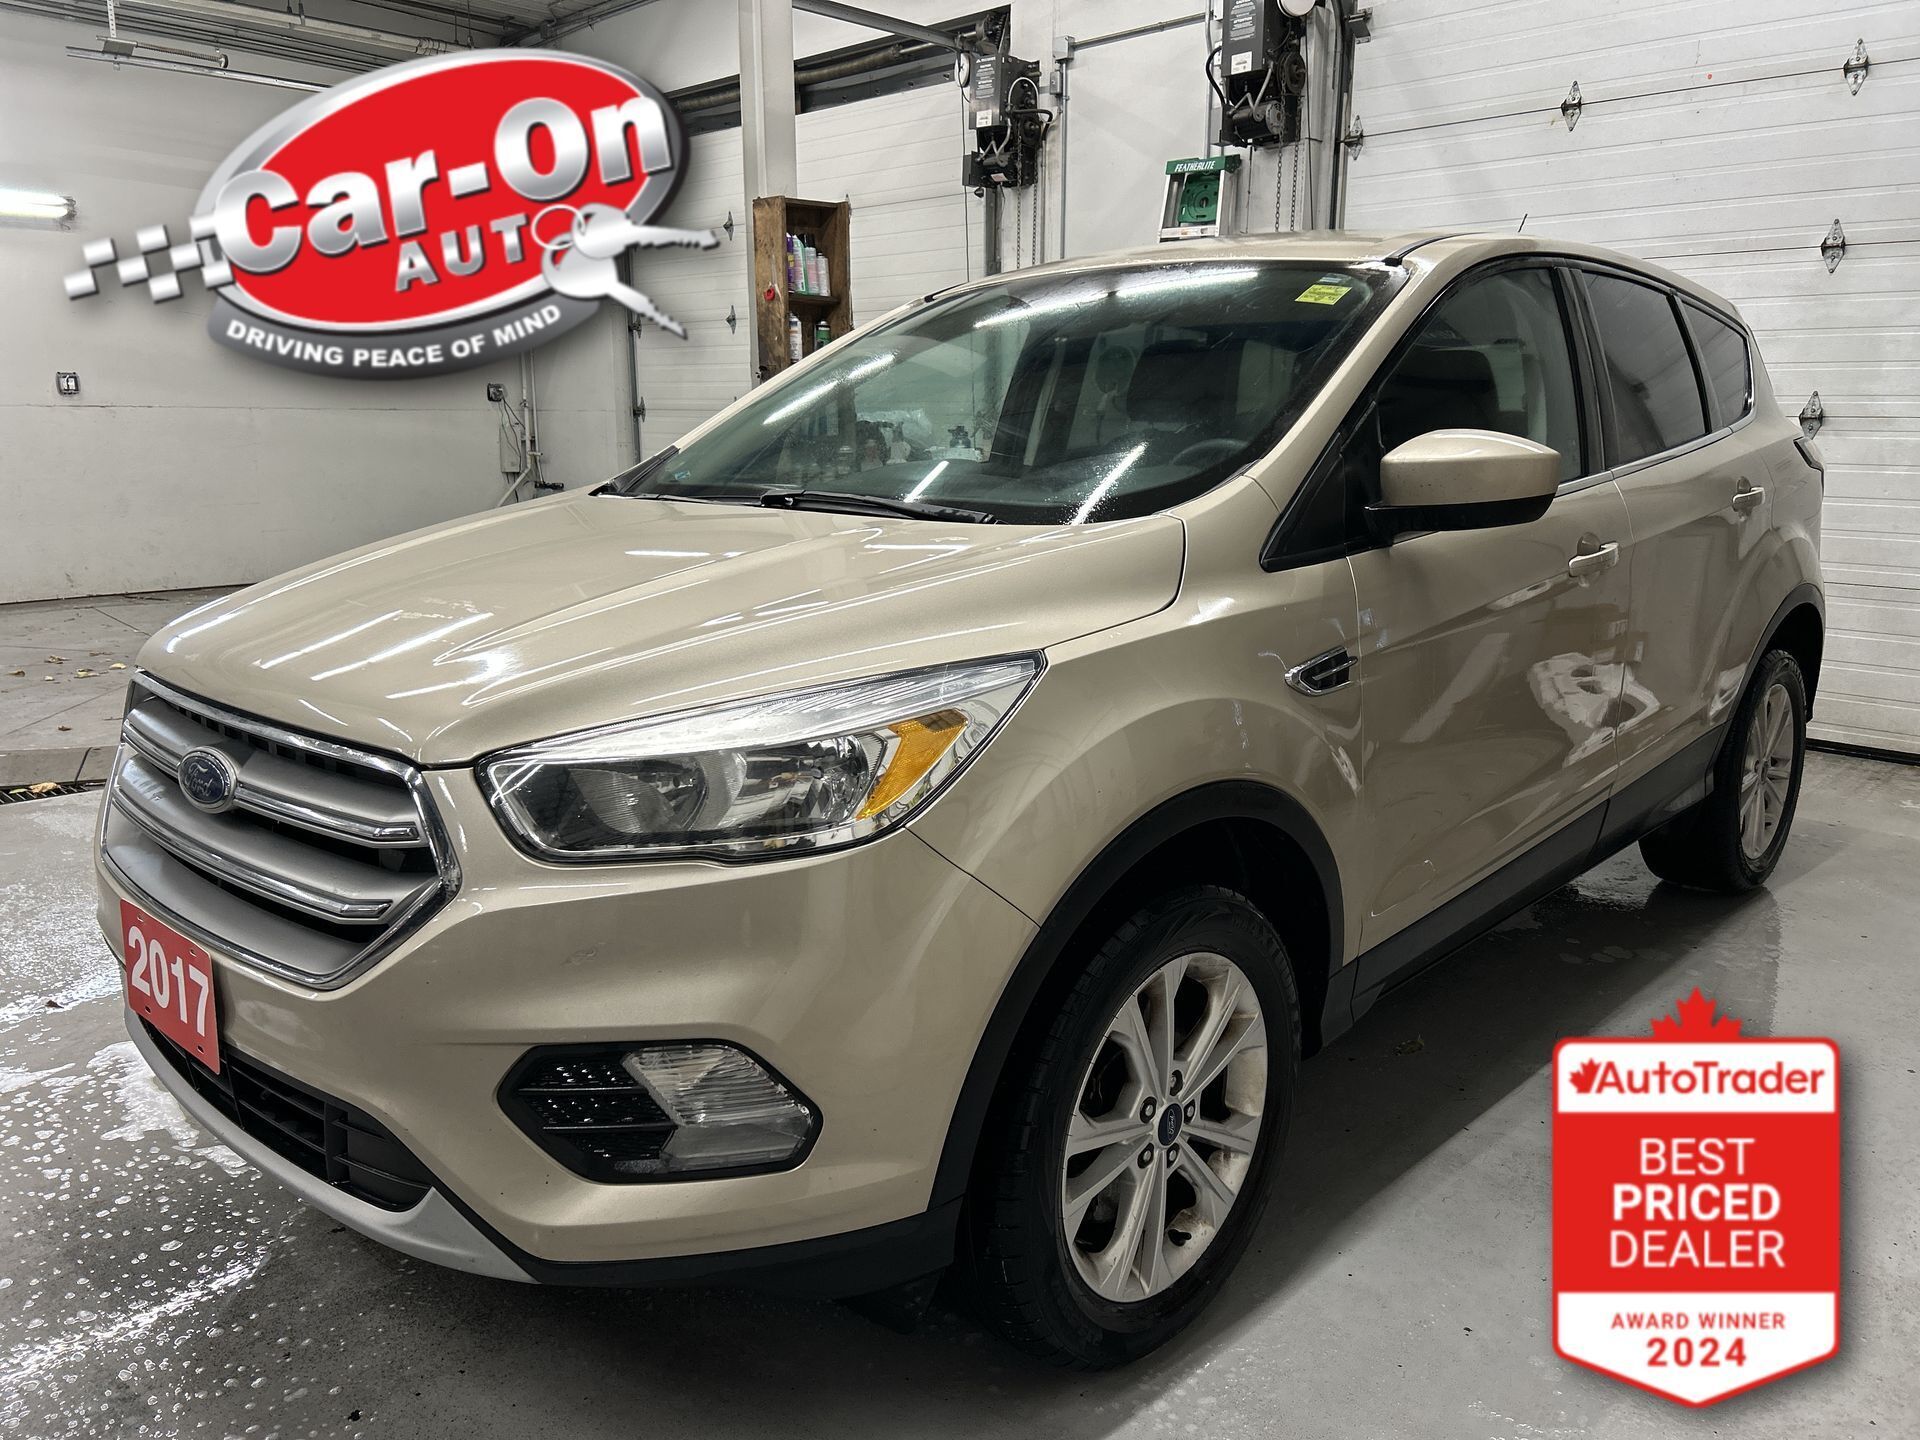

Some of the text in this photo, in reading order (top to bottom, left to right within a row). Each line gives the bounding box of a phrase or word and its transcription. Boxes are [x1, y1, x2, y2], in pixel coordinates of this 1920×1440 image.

[1174, 160, 1216, 173] FEATHERLITE
[184, 762, 214, 797] Ford
[128, 925, 210, 1037] 2017
